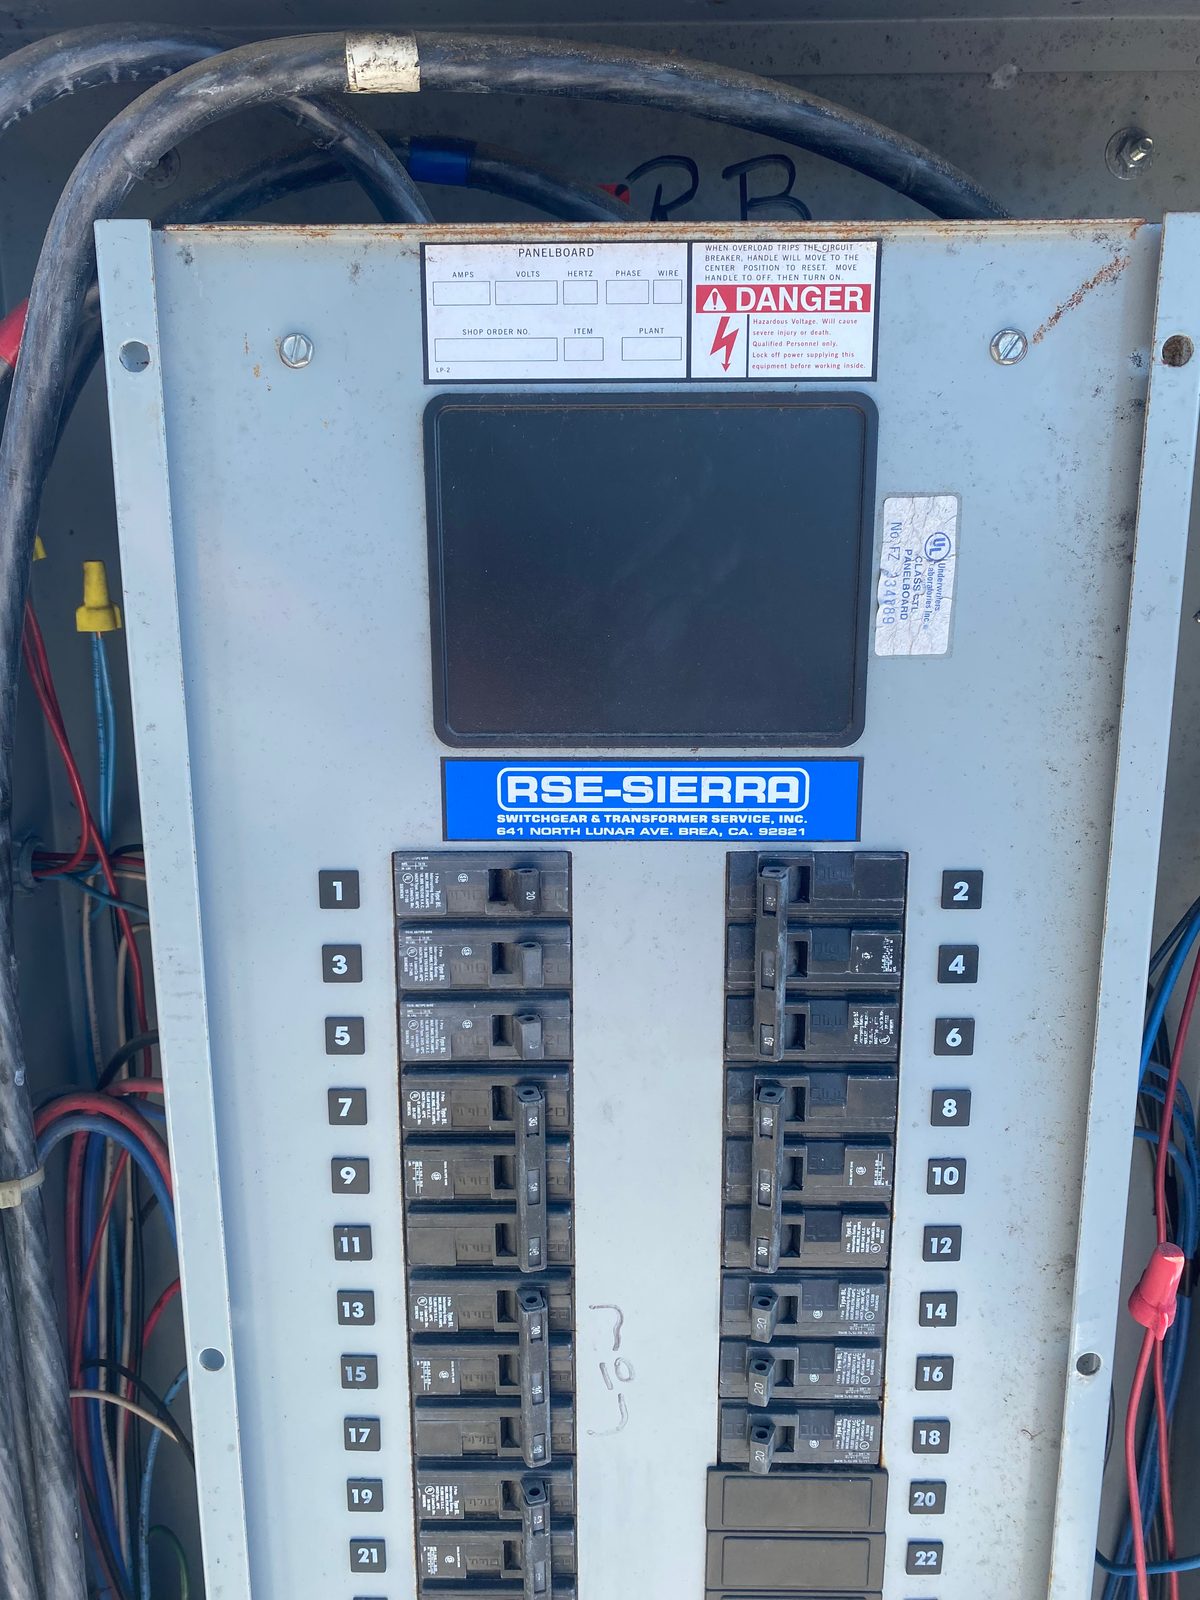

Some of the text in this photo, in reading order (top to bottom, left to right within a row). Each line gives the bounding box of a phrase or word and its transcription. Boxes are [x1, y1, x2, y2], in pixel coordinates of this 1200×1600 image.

[519, 248, 595, 258] PANELBOARD
[705, 244, 854, 252] WHEN OVERLOAD TRIPS THE CIRCUIT
[748, 254, 778, 262] HANDLE
[782, 254, 801, 262] WILL
[805, 254, 827, 262] MOVE
[831, 254, 841, 262] TO
[844, 254, 859, 262] THE
[452, 271, 474, 279] AMPS
[705, 274, 738, 282] HANDLE
[742, 274, 753, 282] TO
[778, 274, 799, 282] THEN
[803, 274, 826, 282] TURN
[736, 286, 864, 312] DANGER
[929, 538, 946, 556] UL
[914, 556, 923, 592] CLASS
[900, 549, 912, 621] PANELBOARD
[935, 562, 946, 612] Underwriters
[507, 775, 800, 804] RSE-SIERRA
[497, 814, 808, 825] SWITCHGEAR & TRANSFORMER SERVICE, INC.
[497, 827, 806, 838] 641 NORTH LUNAR AVE. BREA, CA. 92821
[332, 881, 343, 901] 1
[526, 891, 536, 901] 20
[953, 882, 969, 901] 2
[332, 955, 348, 975] 3
[948, 955, 966, 975] 4
[334, 1026, 351, 1046] 5
[946, 1028, 962, 1048] 6
[338, 1098, 353, 1117] 7
[942, 1099, 958, 1118] 8
[763, 1117, 774, 1128] 30
[340, 1167, 357, 1185] 9
[932, 1167, 959, 1185] 10
[760, 1183, 772, 1193] 30
[340, 1237, 361, 1253] 11
[758, 1247, 769, 1257] 30
[930, 1237, 952, 1254] 12
[841, 1288, 846, 1296] BL
[342, 1302, 365, 1318] 13
[925, 1304, 947, 1319] 14
[532, 1325, 541, 1336] 30
[756, 1317, 768, 1331] 20
[345, 1366, 367, 1383] 15
[922, 1366, 944, 1382] 16
[753, 1382, 765, 1396] 20
[349, 1428, 371, 1443] 17
[920, 1429, 941, 1445] 18
[755, 1450, 766, 1464] 20
[352, 1489, 373, 1504] 19
[914, 1492, 936, 1507] 20
[358, 1548, 379, 1564] 21
[915, 1551, 937, 1566] 22
